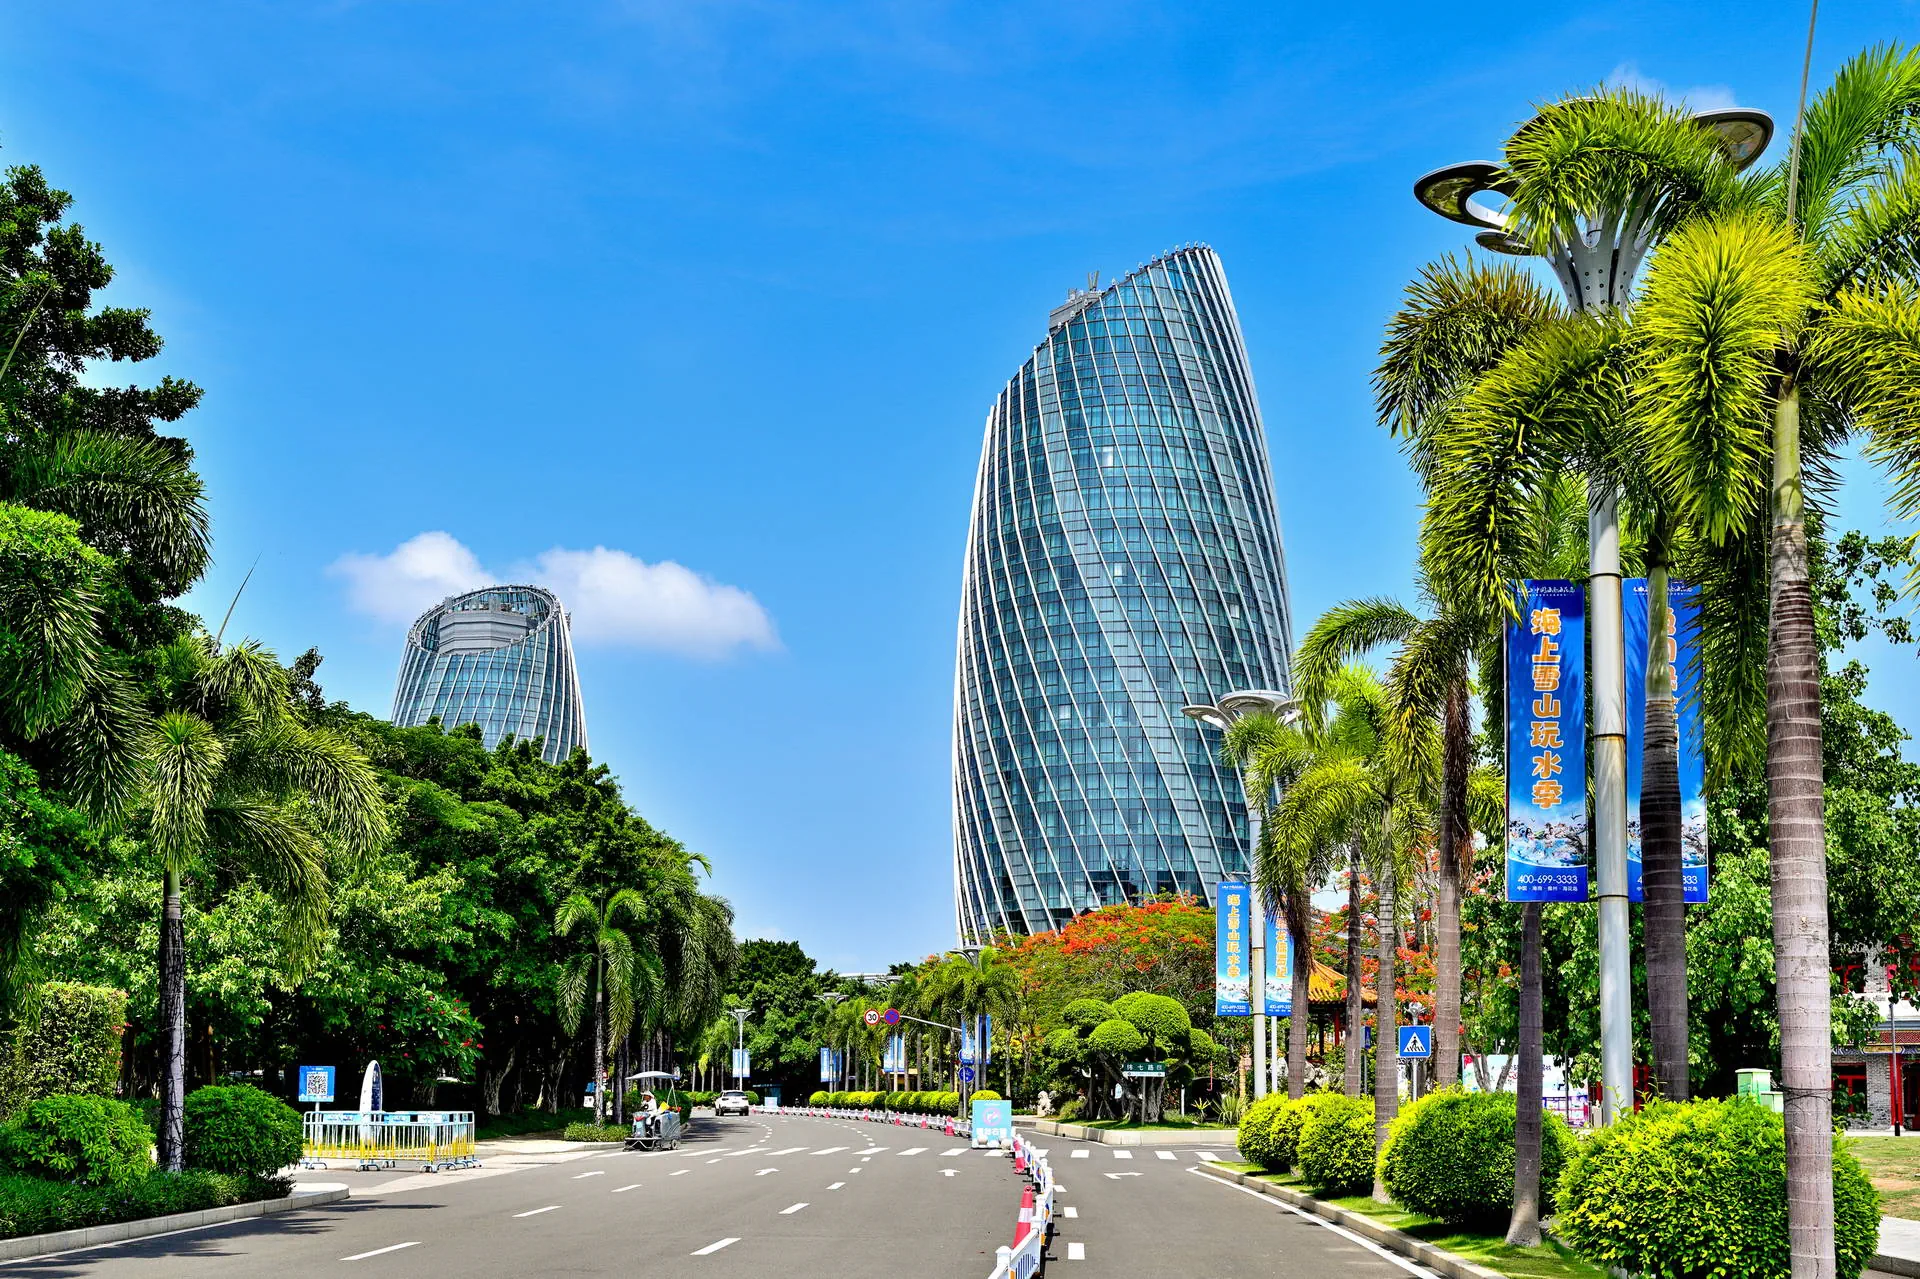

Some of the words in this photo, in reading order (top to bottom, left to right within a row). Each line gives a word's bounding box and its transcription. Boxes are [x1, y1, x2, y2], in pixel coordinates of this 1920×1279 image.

[1530, 607, 1564, 809] 海上雪山玩水季
[1517, 874, 1578, 884] 400-699-3333
[868, 1013, 877, 1022] 30
